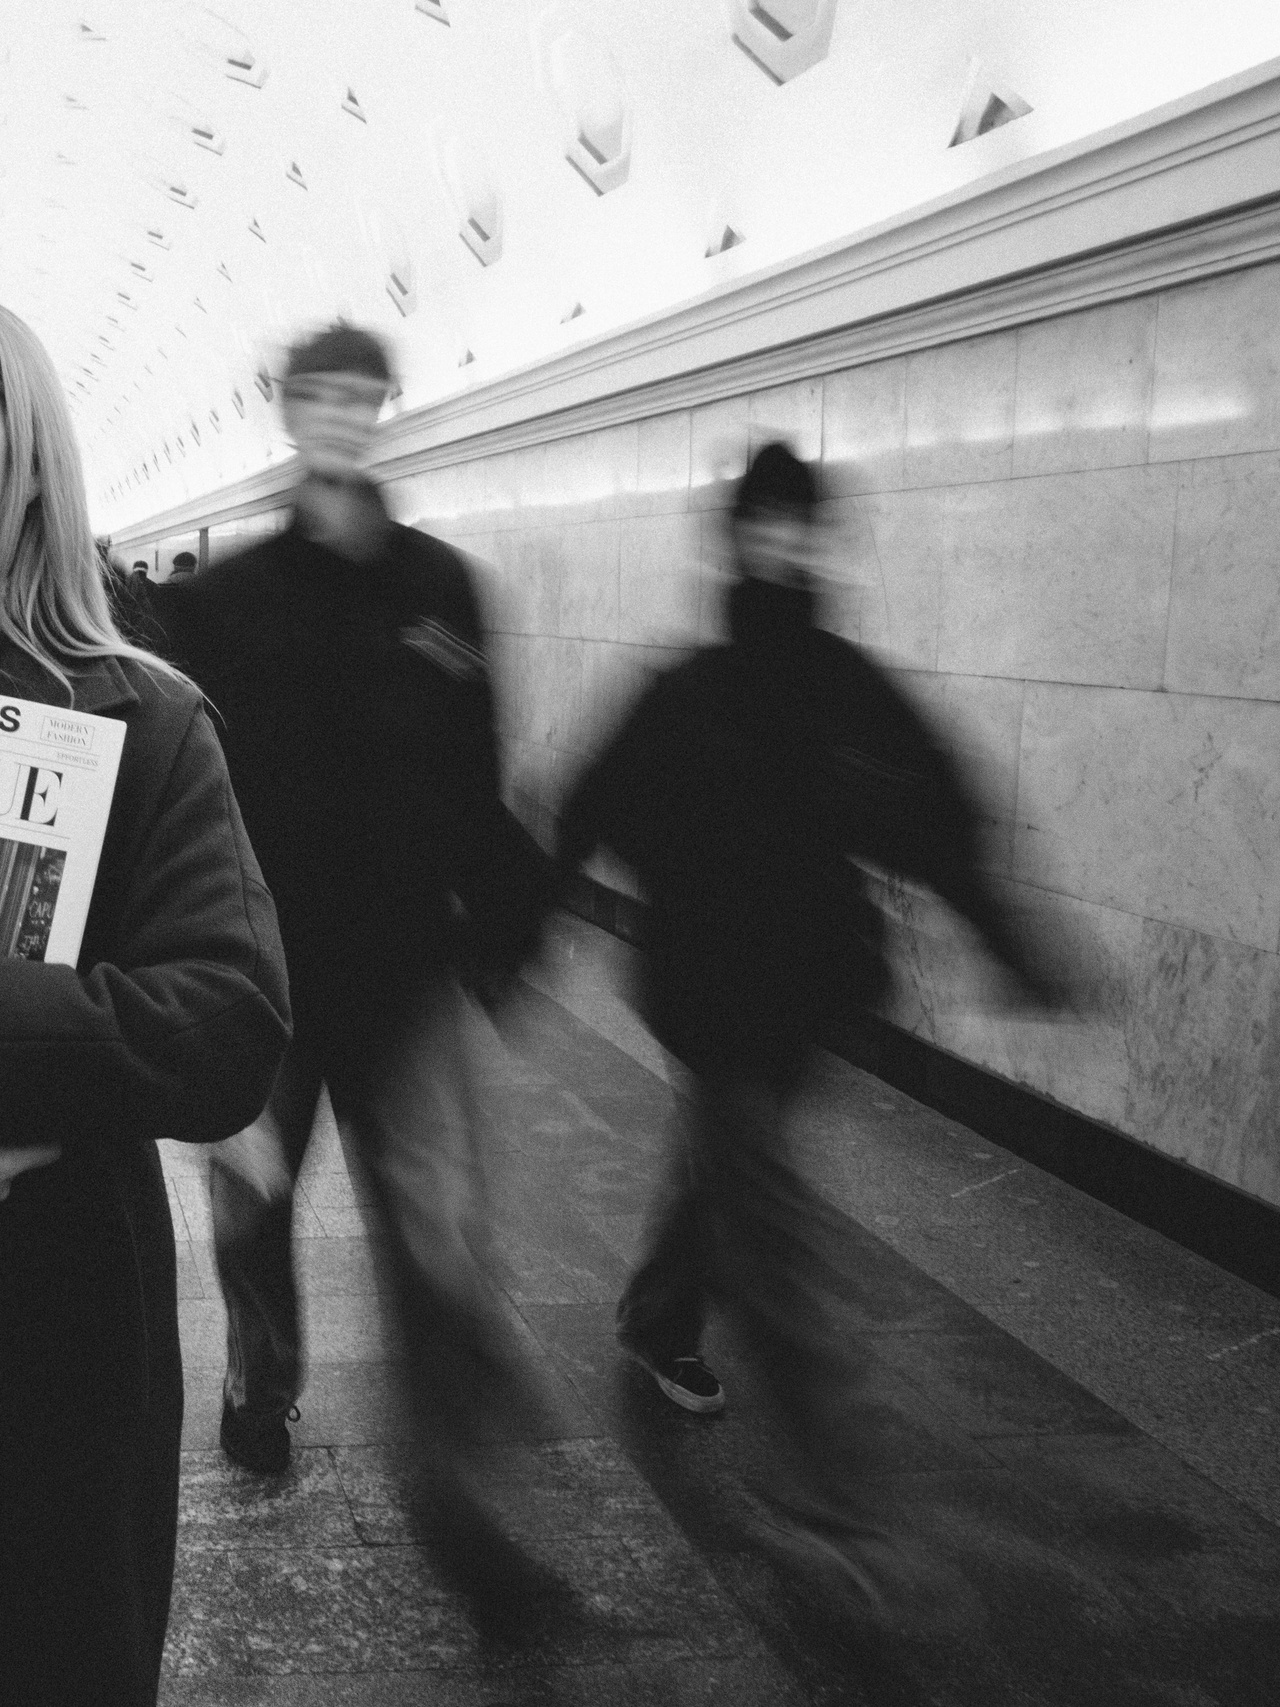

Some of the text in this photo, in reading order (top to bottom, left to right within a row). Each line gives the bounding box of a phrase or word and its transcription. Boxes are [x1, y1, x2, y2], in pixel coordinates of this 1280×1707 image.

[49, 719, 89, 735] MODERN
[46, 731, 87, 746] FASHION
[56, 752, 99, 767] EFFORTLESS
